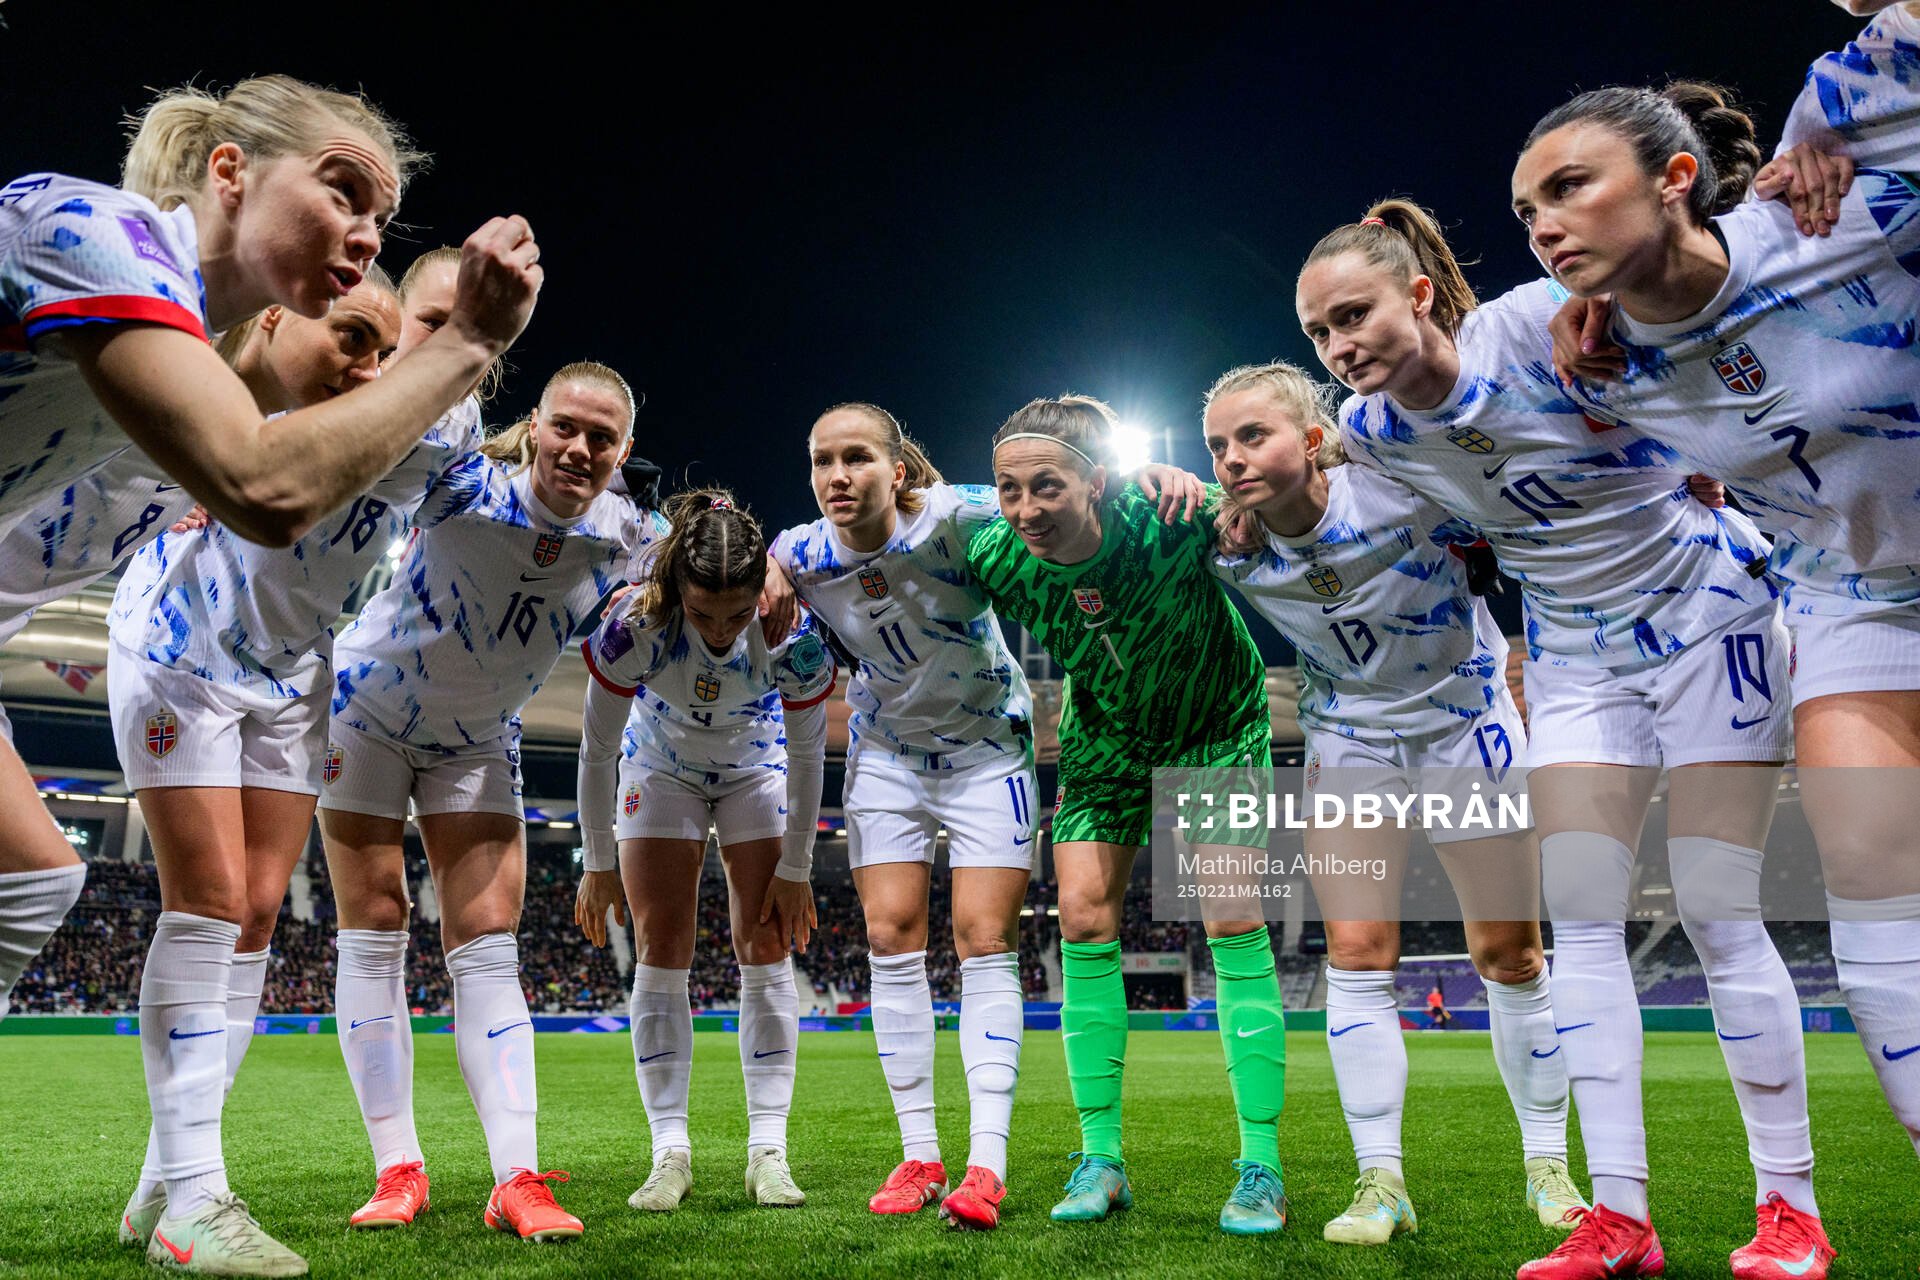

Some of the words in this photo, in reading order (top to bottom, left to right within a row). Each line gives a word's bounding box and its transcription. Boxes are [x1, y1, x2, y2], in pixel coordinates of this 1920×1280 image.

[1770, 424, 1822, 493] 7
[330, 494, 389, 554] 18
[1500, 472, 1584, 528] 10
[112, 502, 165, 561] 8
[496, 591, 546, 648] 16
[877, 622, 920, 666] 11
[1328, 618, 1379, 666] 13
[1099, 633, 1125, 670] 1
[1720, 633, 1773, 705] 10
[692, 710, 713, 727] 4
[1472, 722, 1513, 785] 13
[1004, 776, 1031, 828] 11
